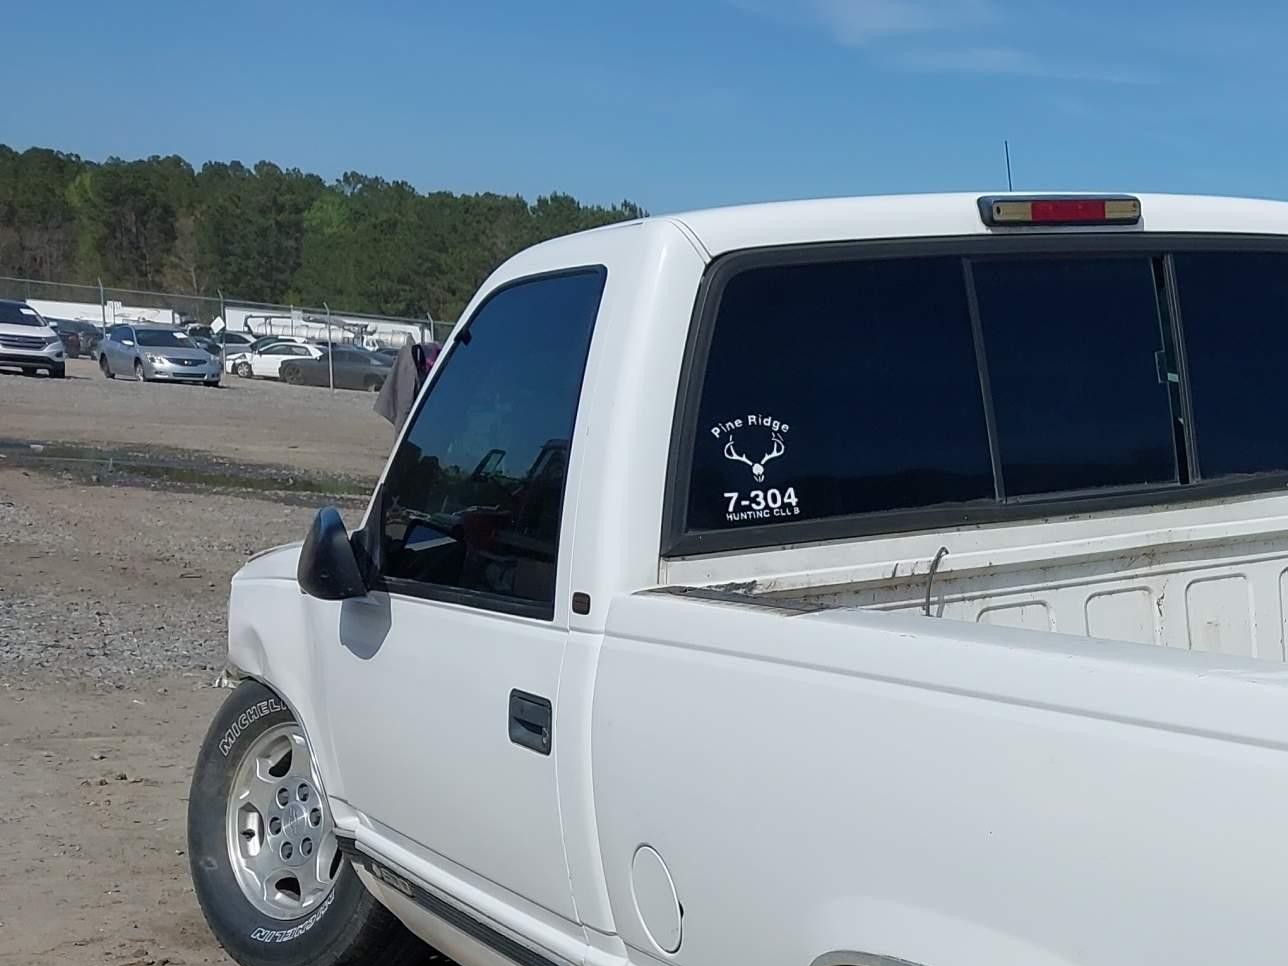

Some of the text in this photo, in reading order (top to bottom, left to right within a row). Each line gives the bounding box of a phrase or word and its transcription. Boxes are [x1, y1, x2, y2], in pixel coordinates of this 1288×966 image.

[711, 414, 790, 438] Pine Ridge
[723, 486, 799, 513] 7-304
[726, 510, 771, 521] HUNTING
[219, 699, 287, 756] MICHELI
